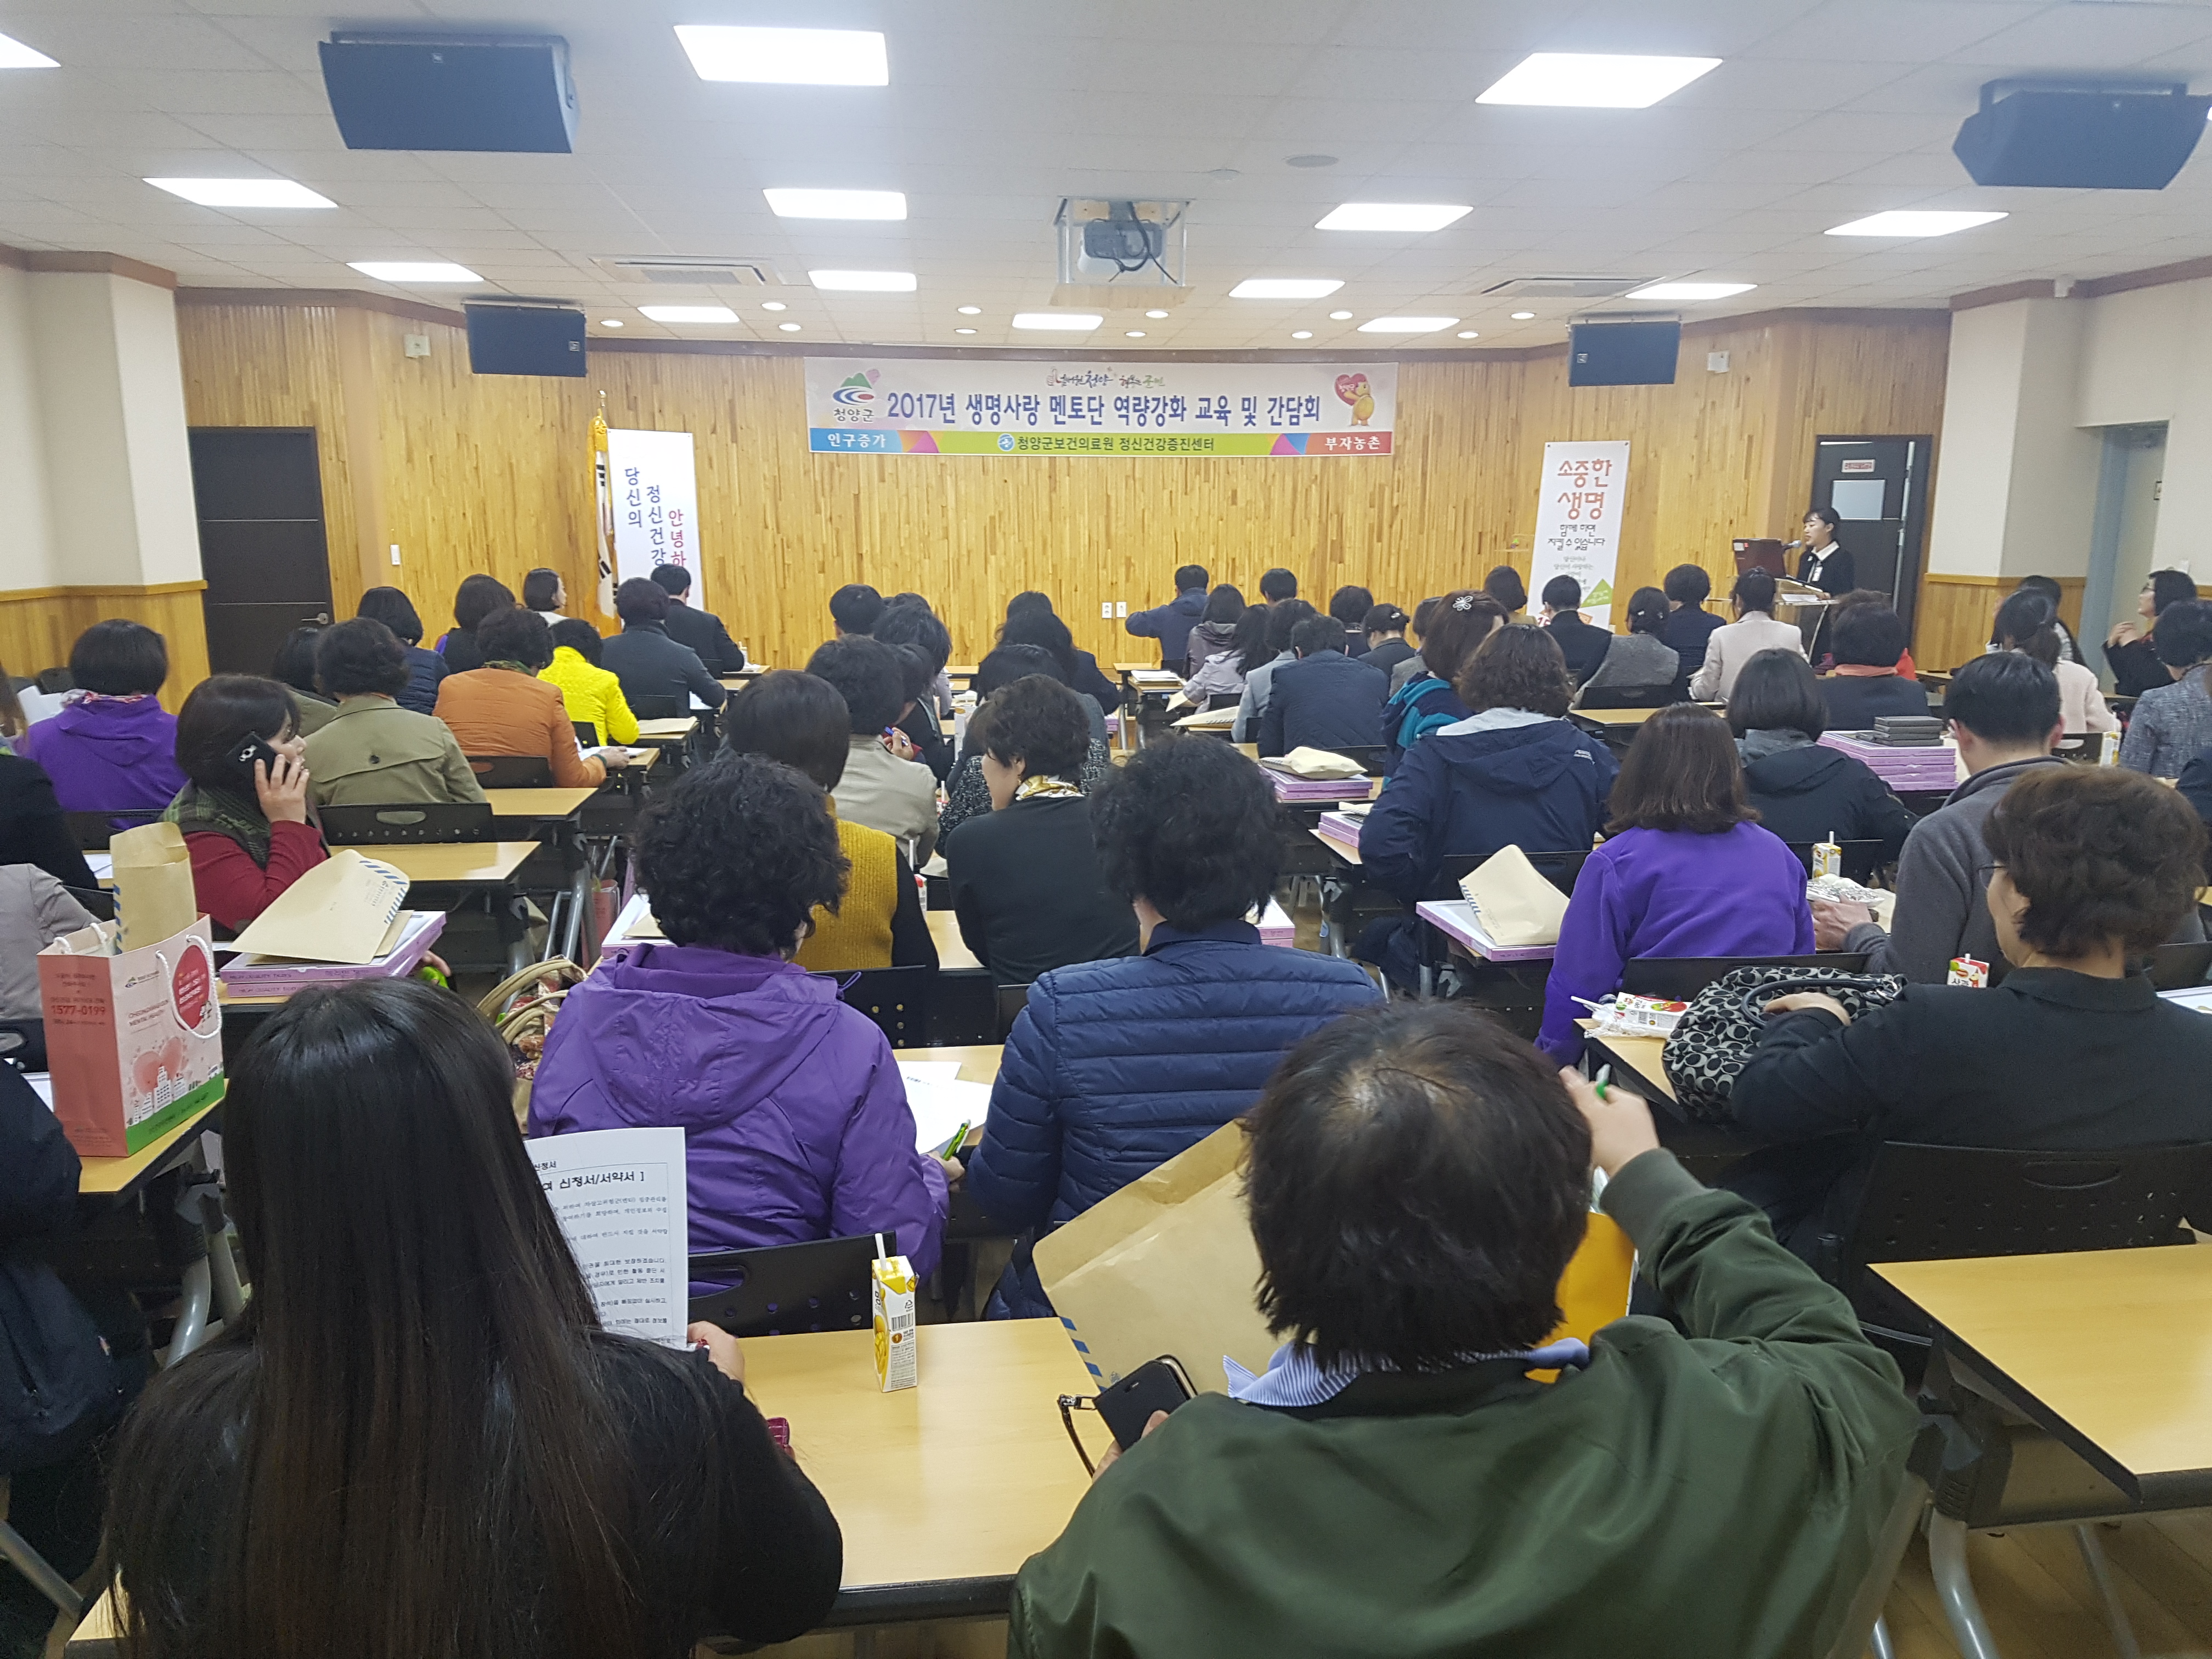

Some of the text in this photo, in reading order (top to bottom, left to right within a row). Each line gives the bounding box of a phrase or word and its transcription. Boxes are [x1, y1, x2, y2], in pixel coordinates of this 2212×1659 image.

[833, 408, 874, 422] 청양군
[887, 392, 1320, 427] 2017년 생명사랑 멘토단 역량강화 교육 및 간담회
[827, 433, 887, 448] 인구증가
[1018, 436, 1215, 452] 청양군보건의료원 정신건강증진센터
[1325, 437, 1380, 451] 부자농촌
[1557, 459, 1612, 488] 소중한
[625, 467, 642, 528] 당신의
[1558, 492, 1605, 520] 생명
[647, 485, 666, 566] 정신건강
[1548, 538, 1564, 550] 지킬
[1574, 538, 1605, 550] 있습니다
[51, 1005, 105, 1015] 1577-0199
